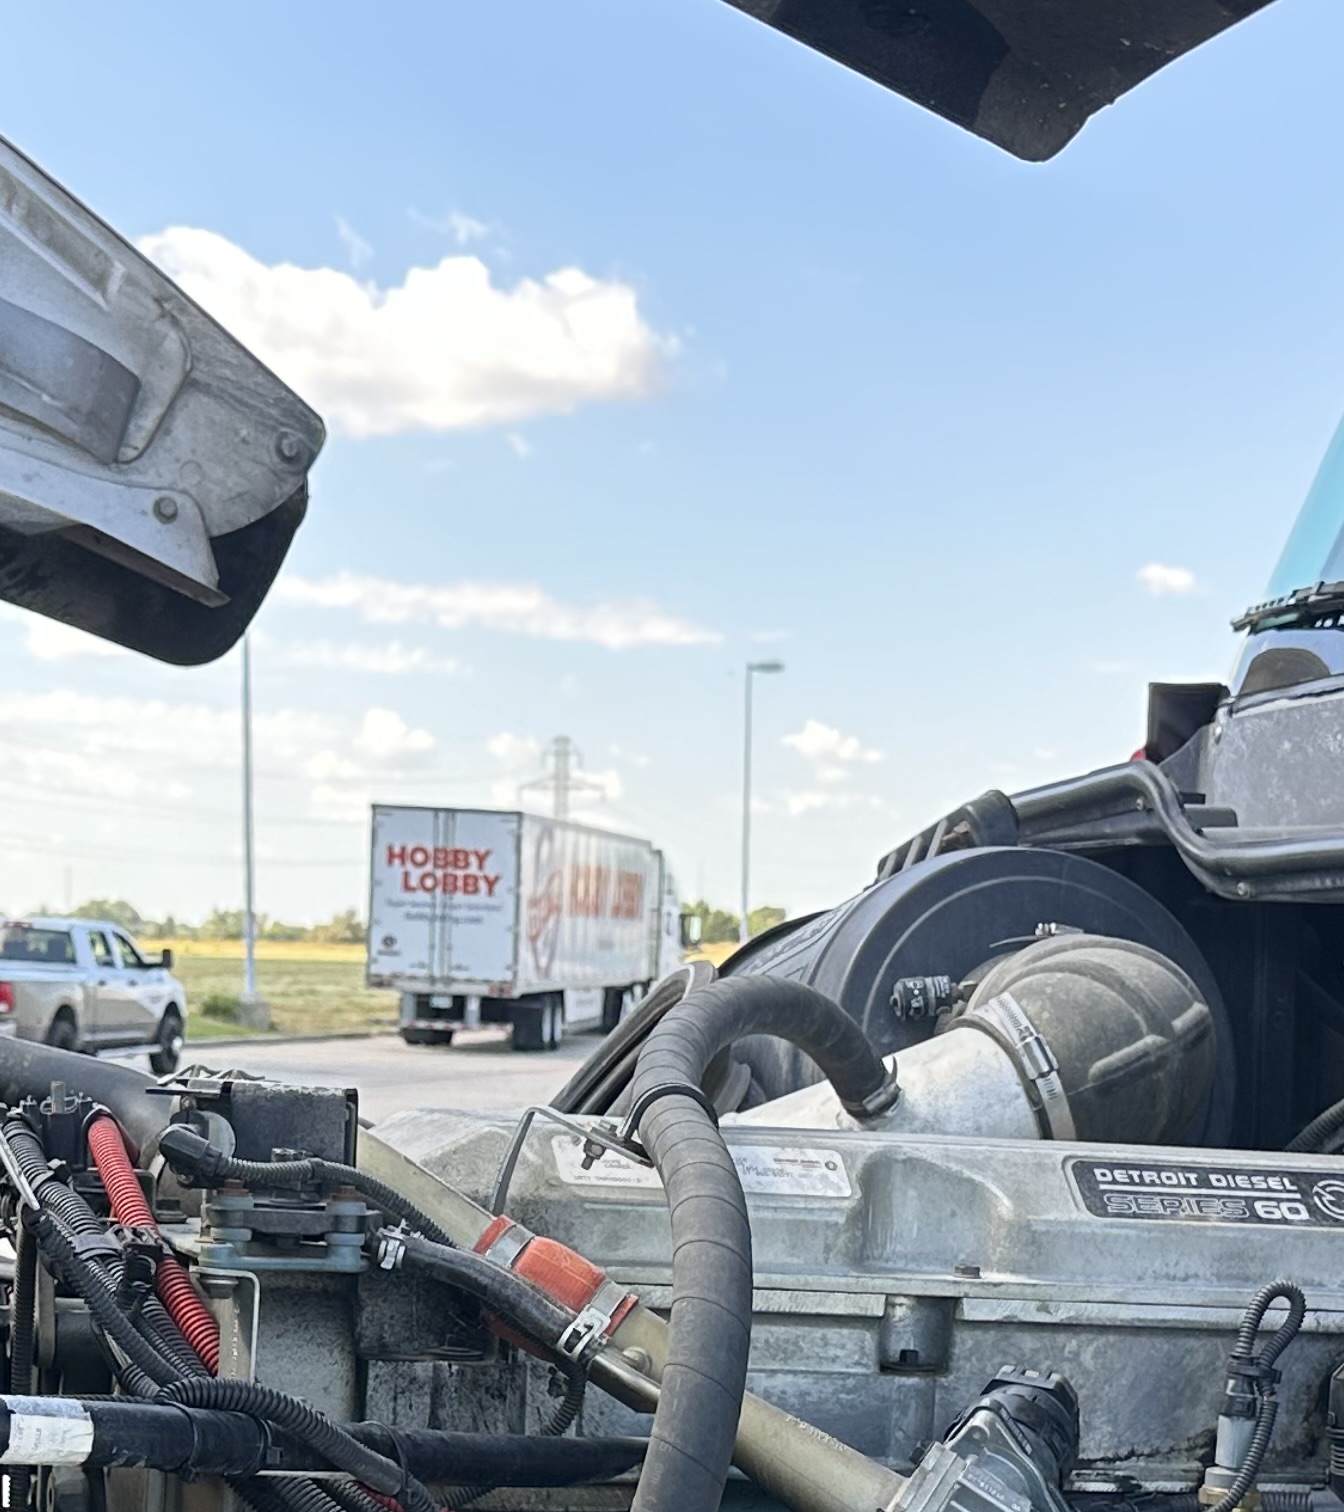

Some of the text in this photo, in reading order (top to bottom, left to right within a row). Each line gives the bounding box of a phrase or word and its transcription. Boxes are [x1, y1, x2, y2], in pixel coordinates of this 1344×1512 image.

[386, 845, 492, 871] HOBBY
[401, 871, 502, 897] LOBBY
[1093, 1167, 1299, 1192] DETROIT DIESEL
[1103, 1193, 1310, 1221] SERIES 60
